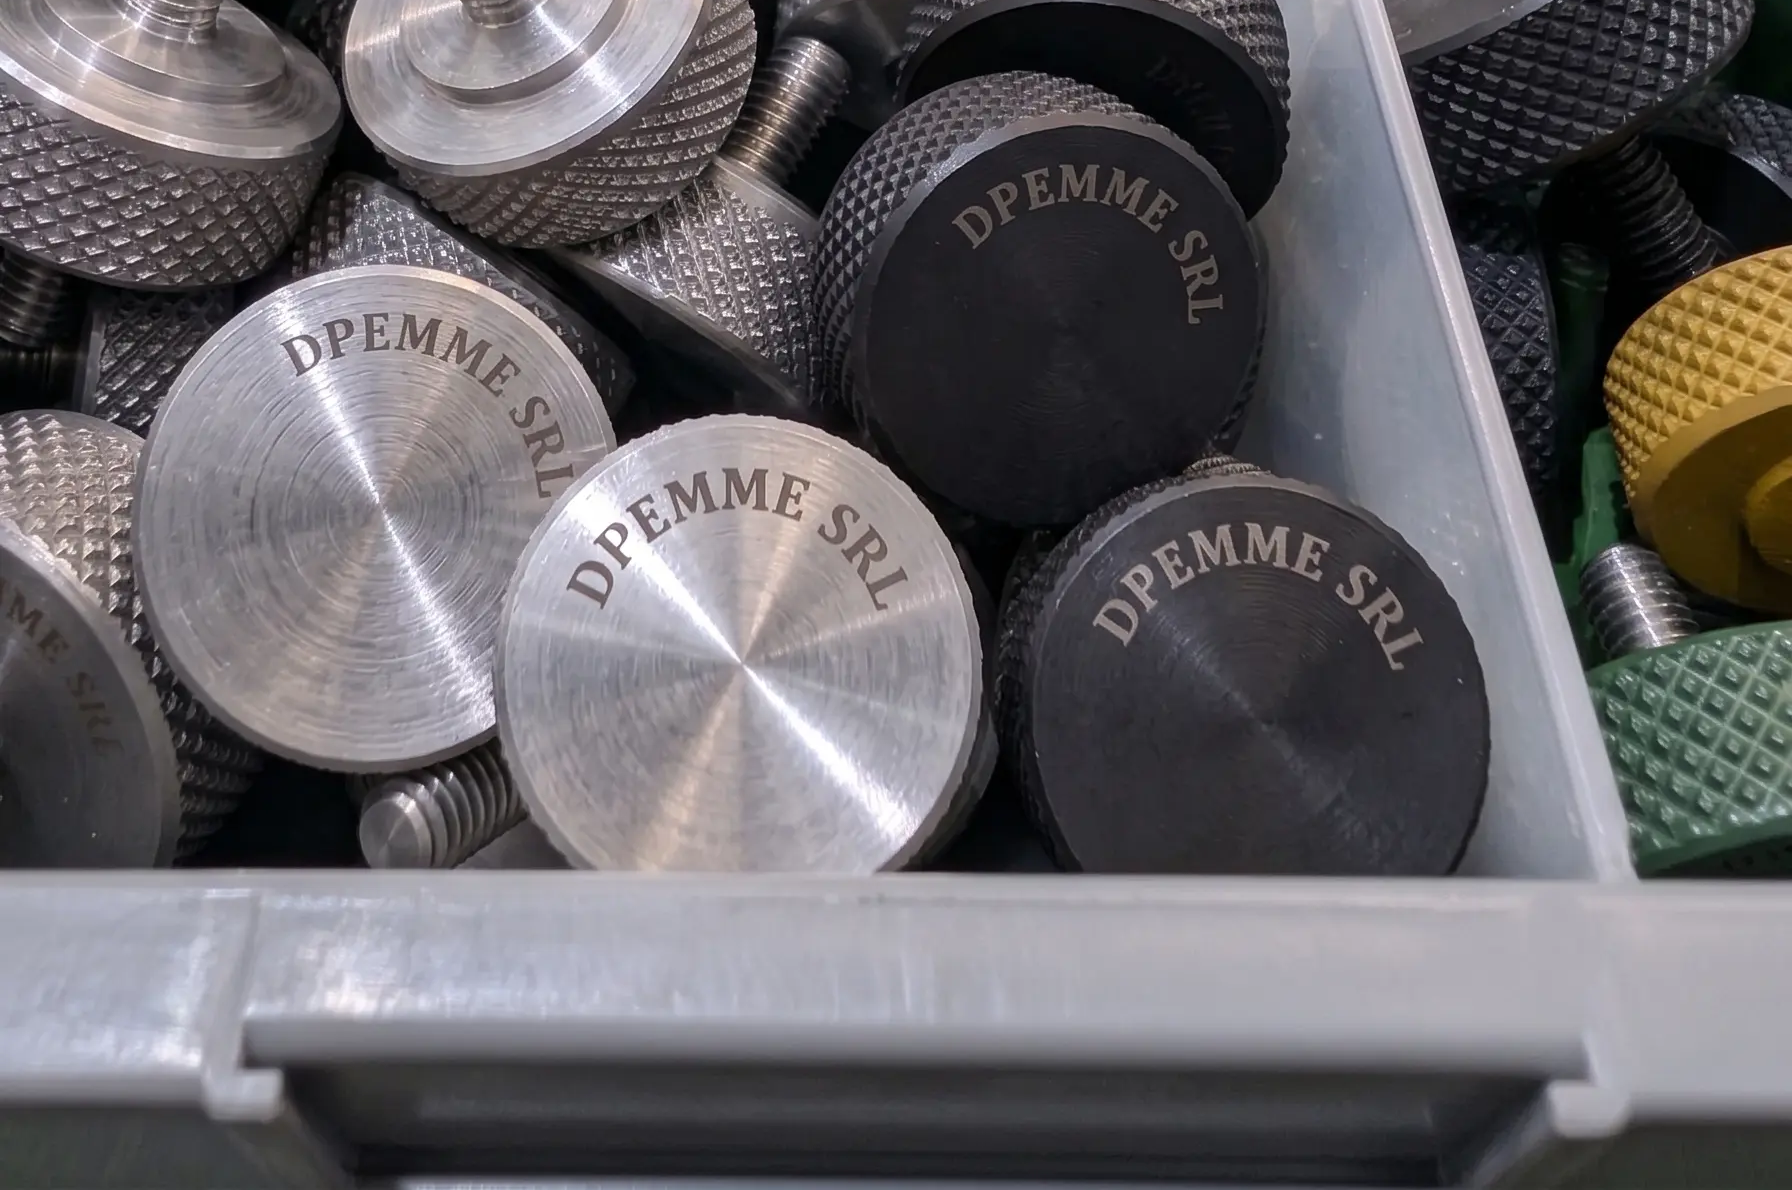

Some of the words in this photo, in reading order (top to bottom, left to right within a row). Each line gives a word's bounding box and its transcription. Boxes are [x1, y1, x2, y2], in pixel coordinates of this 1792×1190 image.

[951, 164, 1180, 250] DPEMME
[1167, 230, 1224, 325] SRL
[280, 312, 522, 398] DPEMME
[508, 396, 574, 499] SRL
[566, 467, 811, 610] DPEMME
[817, 503, 908, 611] SRL
[1092, 522, 1331, 647] DPEMME
[1335, 564, 1425, 671] SRL
